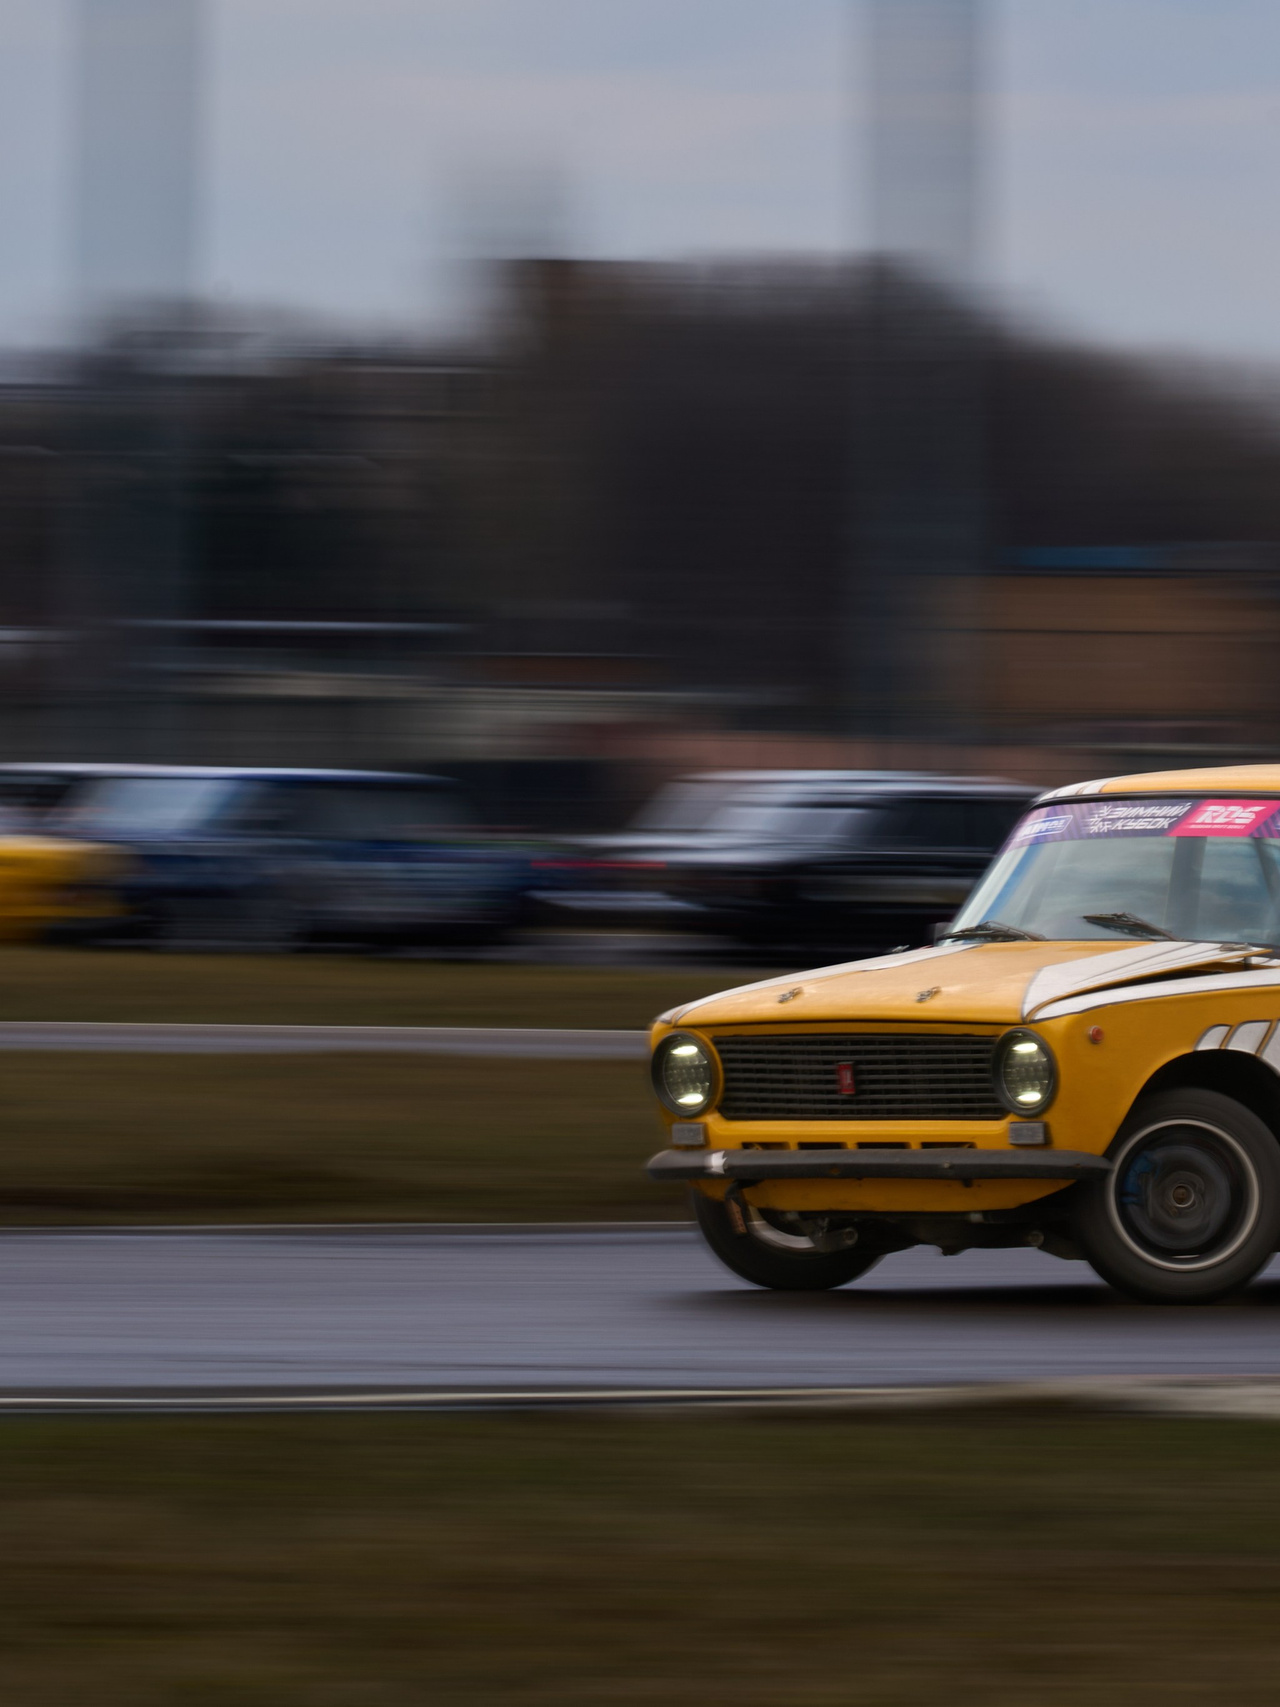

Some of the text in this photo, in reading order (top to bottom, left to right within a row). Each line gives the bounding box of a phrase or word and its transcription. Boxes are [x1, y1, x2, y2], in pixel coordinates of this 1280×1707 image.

[1107, 802, 1192, 818] ЗИМНИЙ
[1195, 805, 1267, 824] RDS
[1110, 818, 1178, 830] КУБОК
